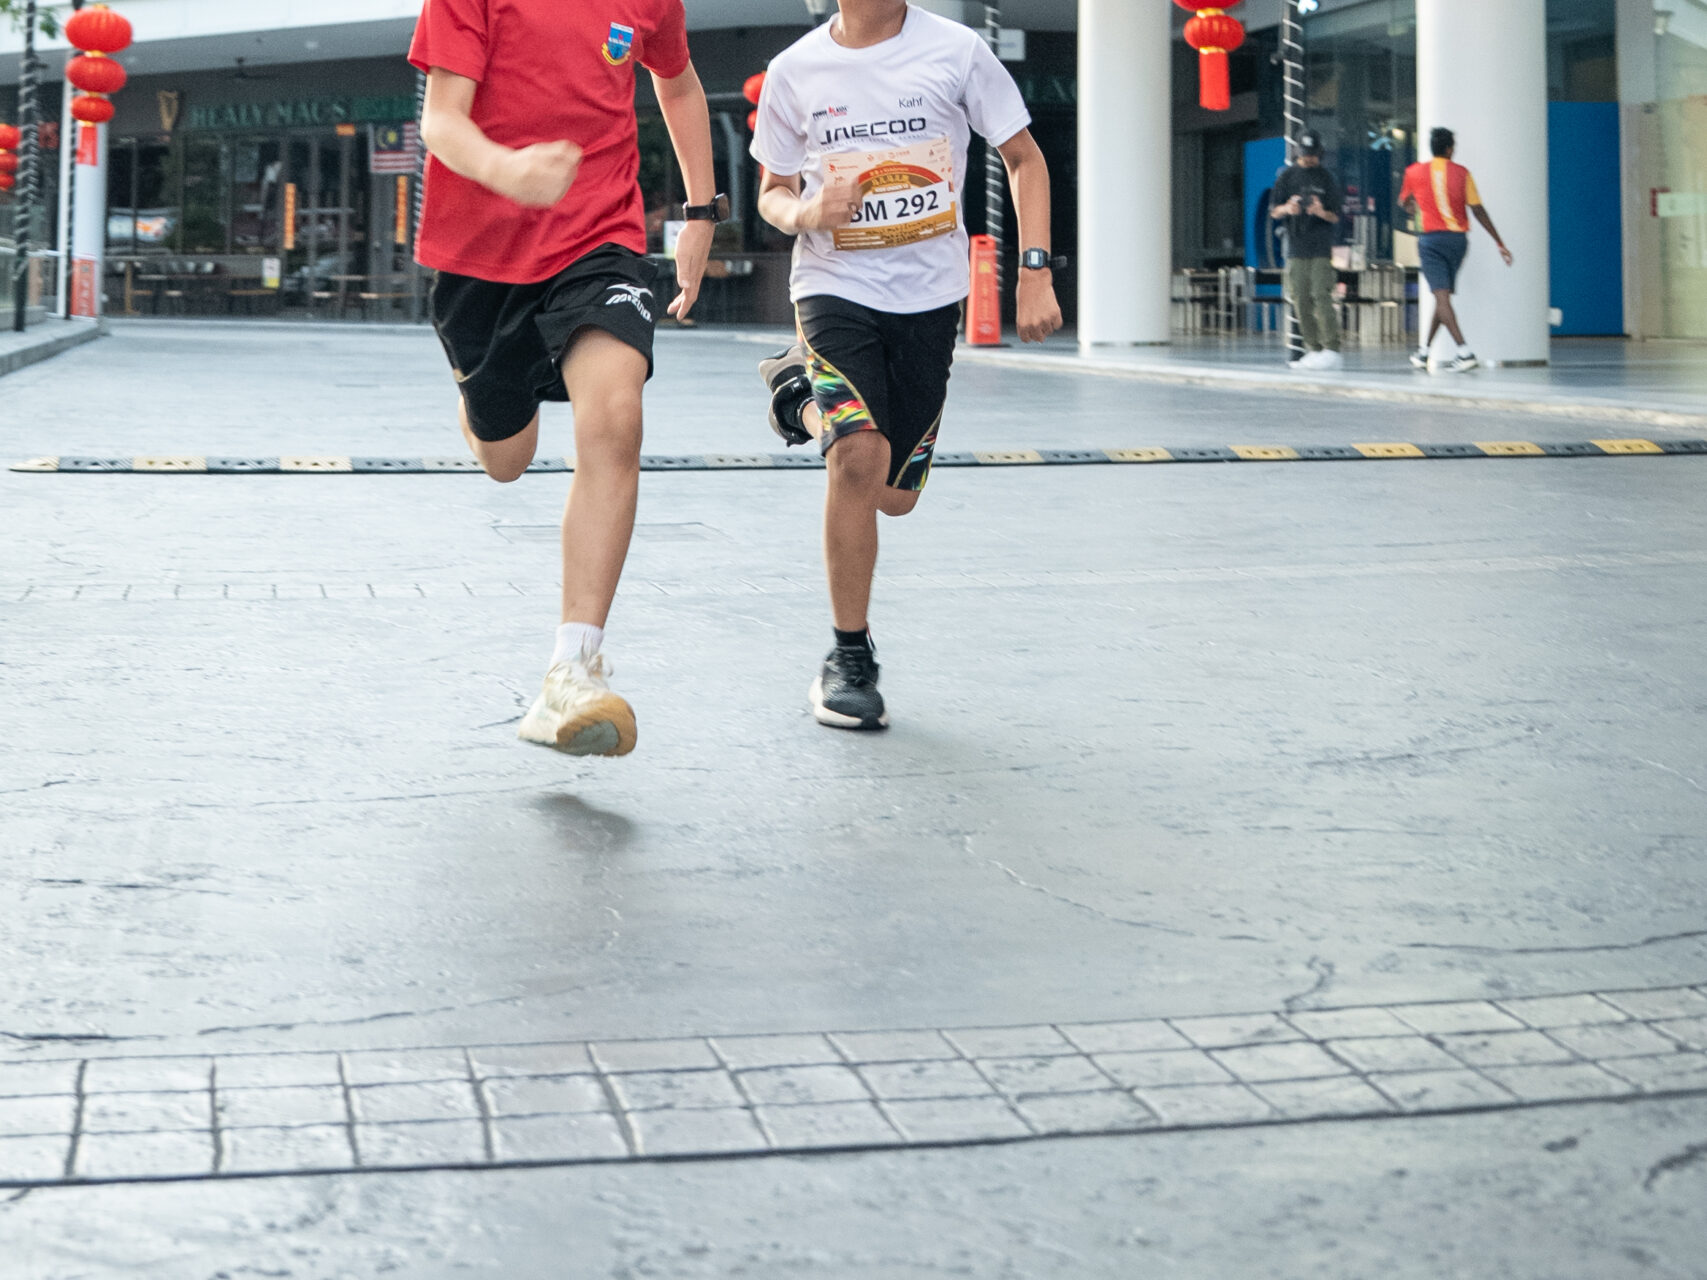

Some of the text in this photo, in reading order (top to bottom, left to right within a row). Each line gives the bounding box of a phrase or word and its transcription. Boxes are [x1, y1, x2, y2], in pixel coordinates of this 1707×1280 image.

[898, 96, 923, 109] Kahf
[820, 117, 927, 145] JAECOO
[895, 190, 939, 218] 292
[605, 293, 651, 321] MIZUNO
